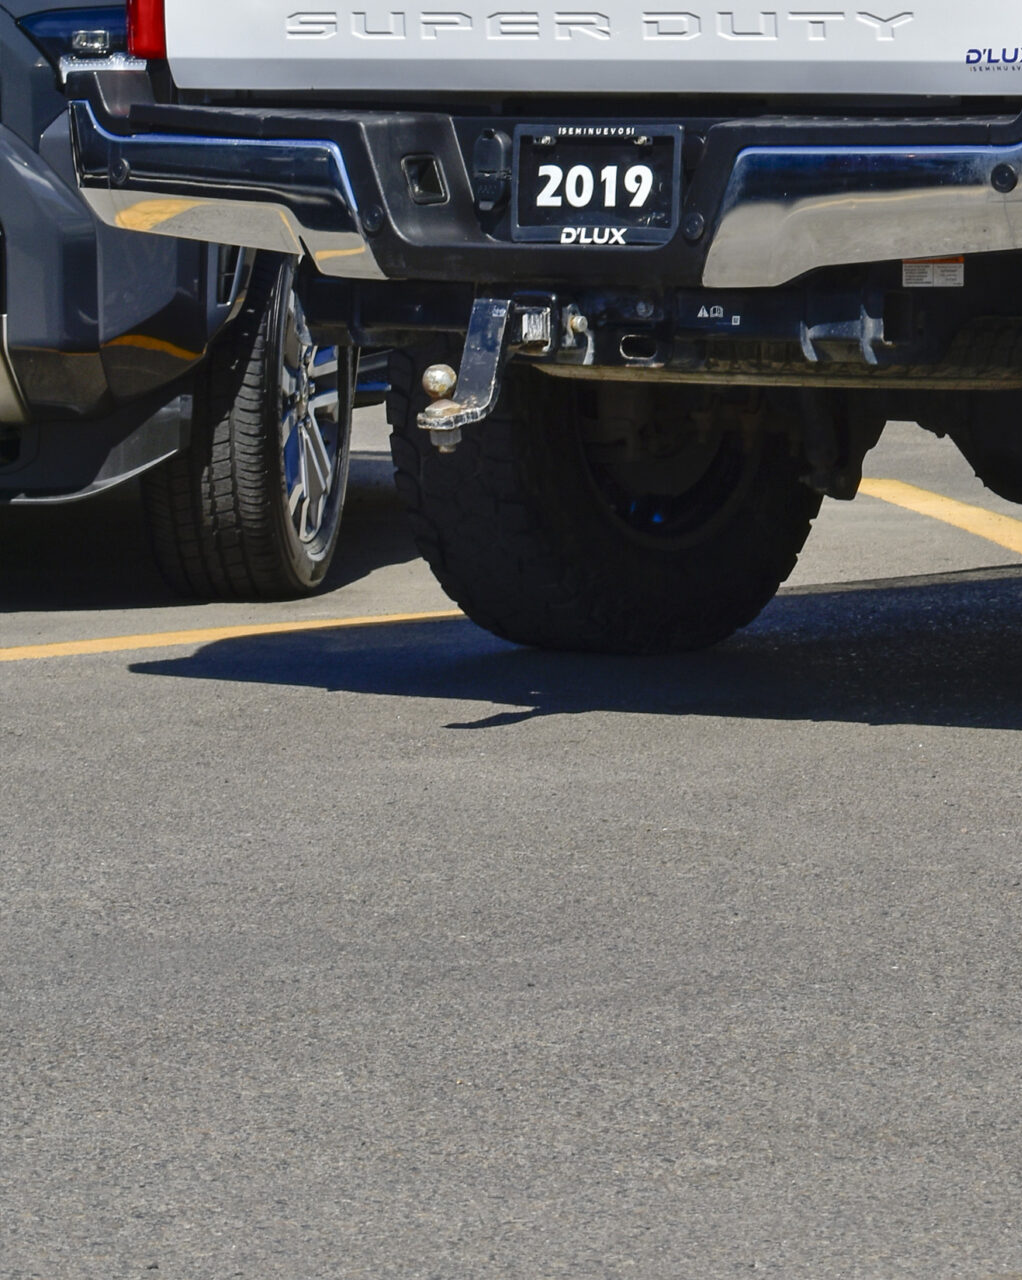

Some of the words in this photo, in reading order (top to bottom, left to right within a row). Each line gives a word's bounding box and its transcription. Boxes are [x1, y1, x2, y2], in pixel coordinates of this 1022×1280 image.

[287, 11, 611, 41] SUPER
[642, 11, 914, 41] DUTY
[536, 164, 653, 208] 2019
[560, 227, 627, 245] D'LUX
